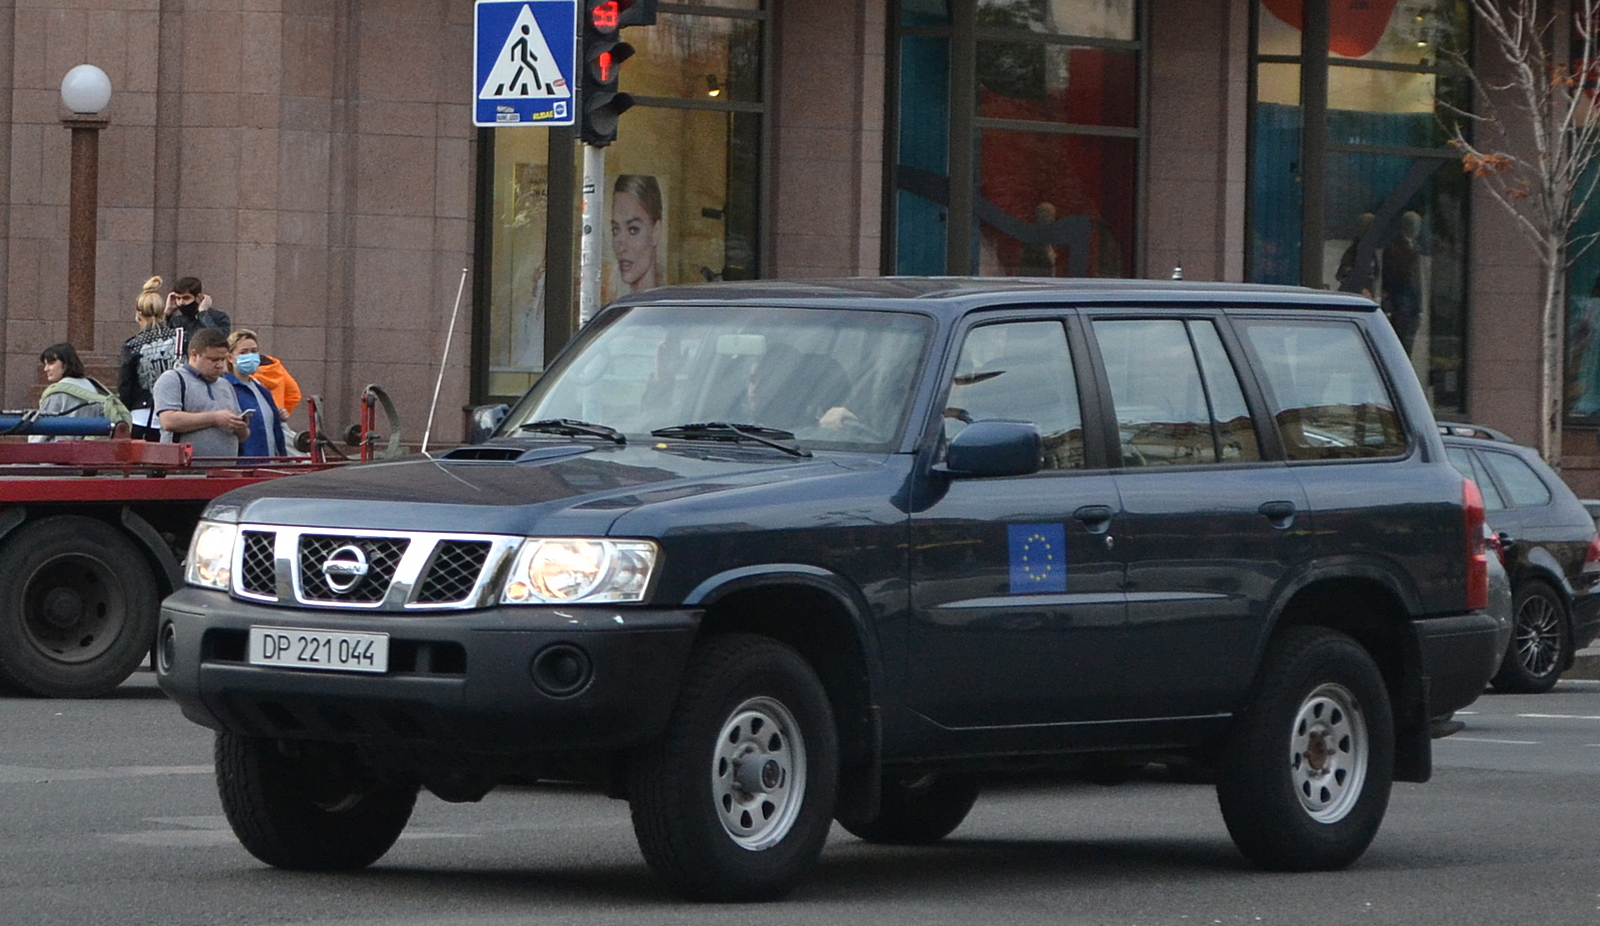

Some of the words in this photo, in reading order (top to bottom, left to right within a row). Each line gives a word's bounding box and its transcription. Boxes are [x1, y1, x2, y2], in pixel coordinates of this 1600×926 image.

[263, 633, 291, 660] DP
[297, 636, 332, 663] 221
[339, 638, 375, 666] 044
